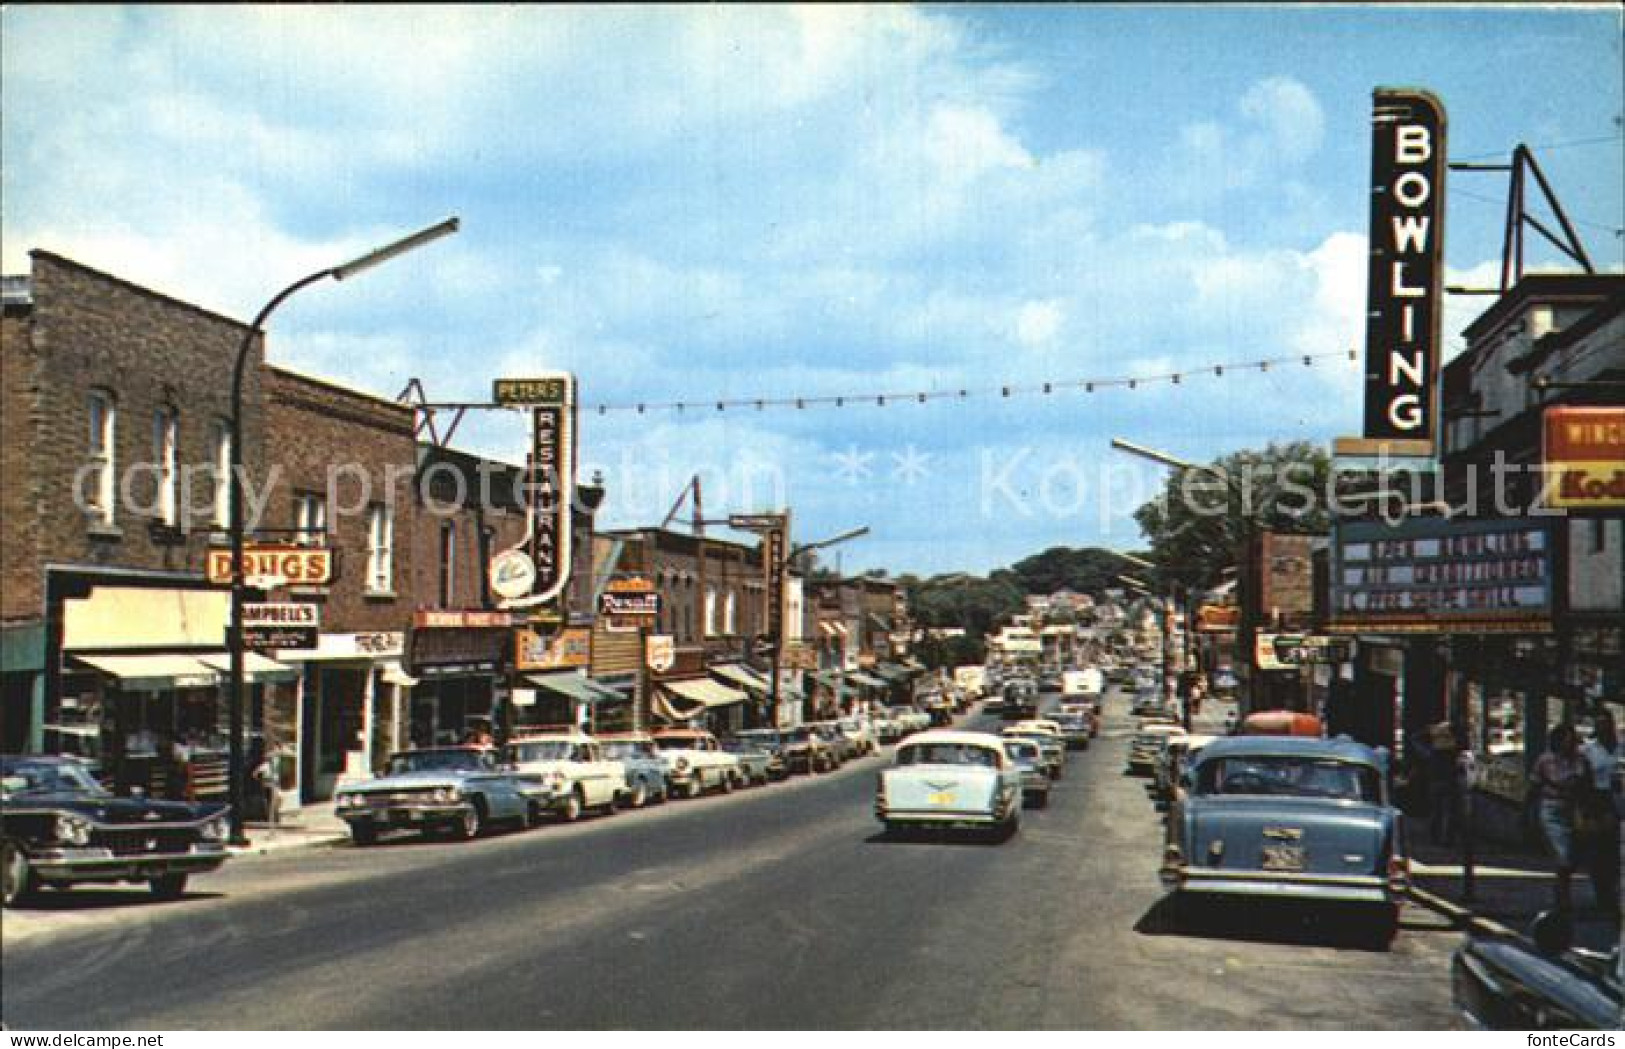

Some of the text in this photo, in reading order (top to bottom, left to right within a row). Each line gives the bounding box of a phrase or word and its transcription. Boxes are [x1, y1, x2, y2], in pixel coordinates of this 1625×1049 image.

[1388, 125, 1431, 429] BOWLING
[538, 411, 555, 582] RESTAURANT
[215, 554, 326, 579] DRUGS
[242, 606, 313, 622] AMPBELL'S
